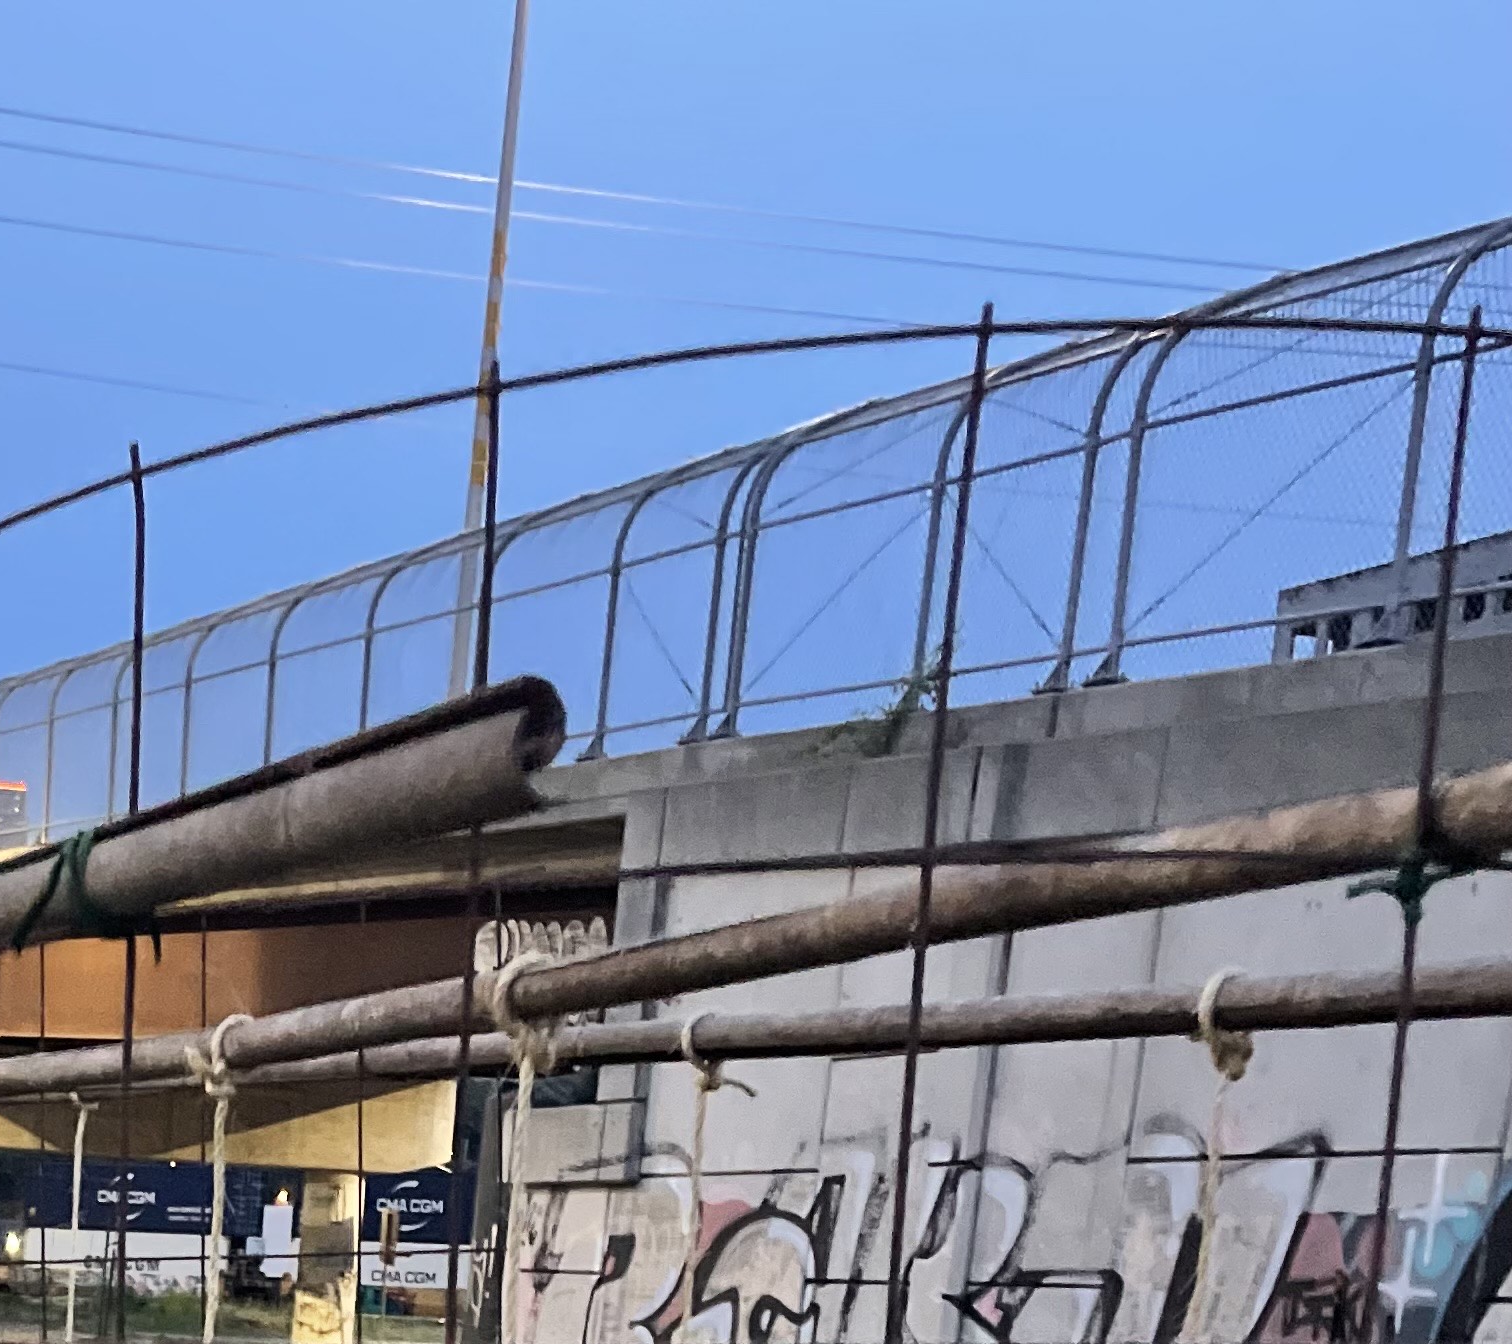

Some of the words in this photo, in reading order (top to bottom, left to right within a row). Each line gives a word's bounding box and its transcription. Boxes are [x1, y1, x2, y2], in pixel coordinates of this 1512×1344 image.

[376, 1198, 407, 1213] CMA
[410, 1199, 444, 1214] CGM
[404, 1270, 437, 1284] CGM
